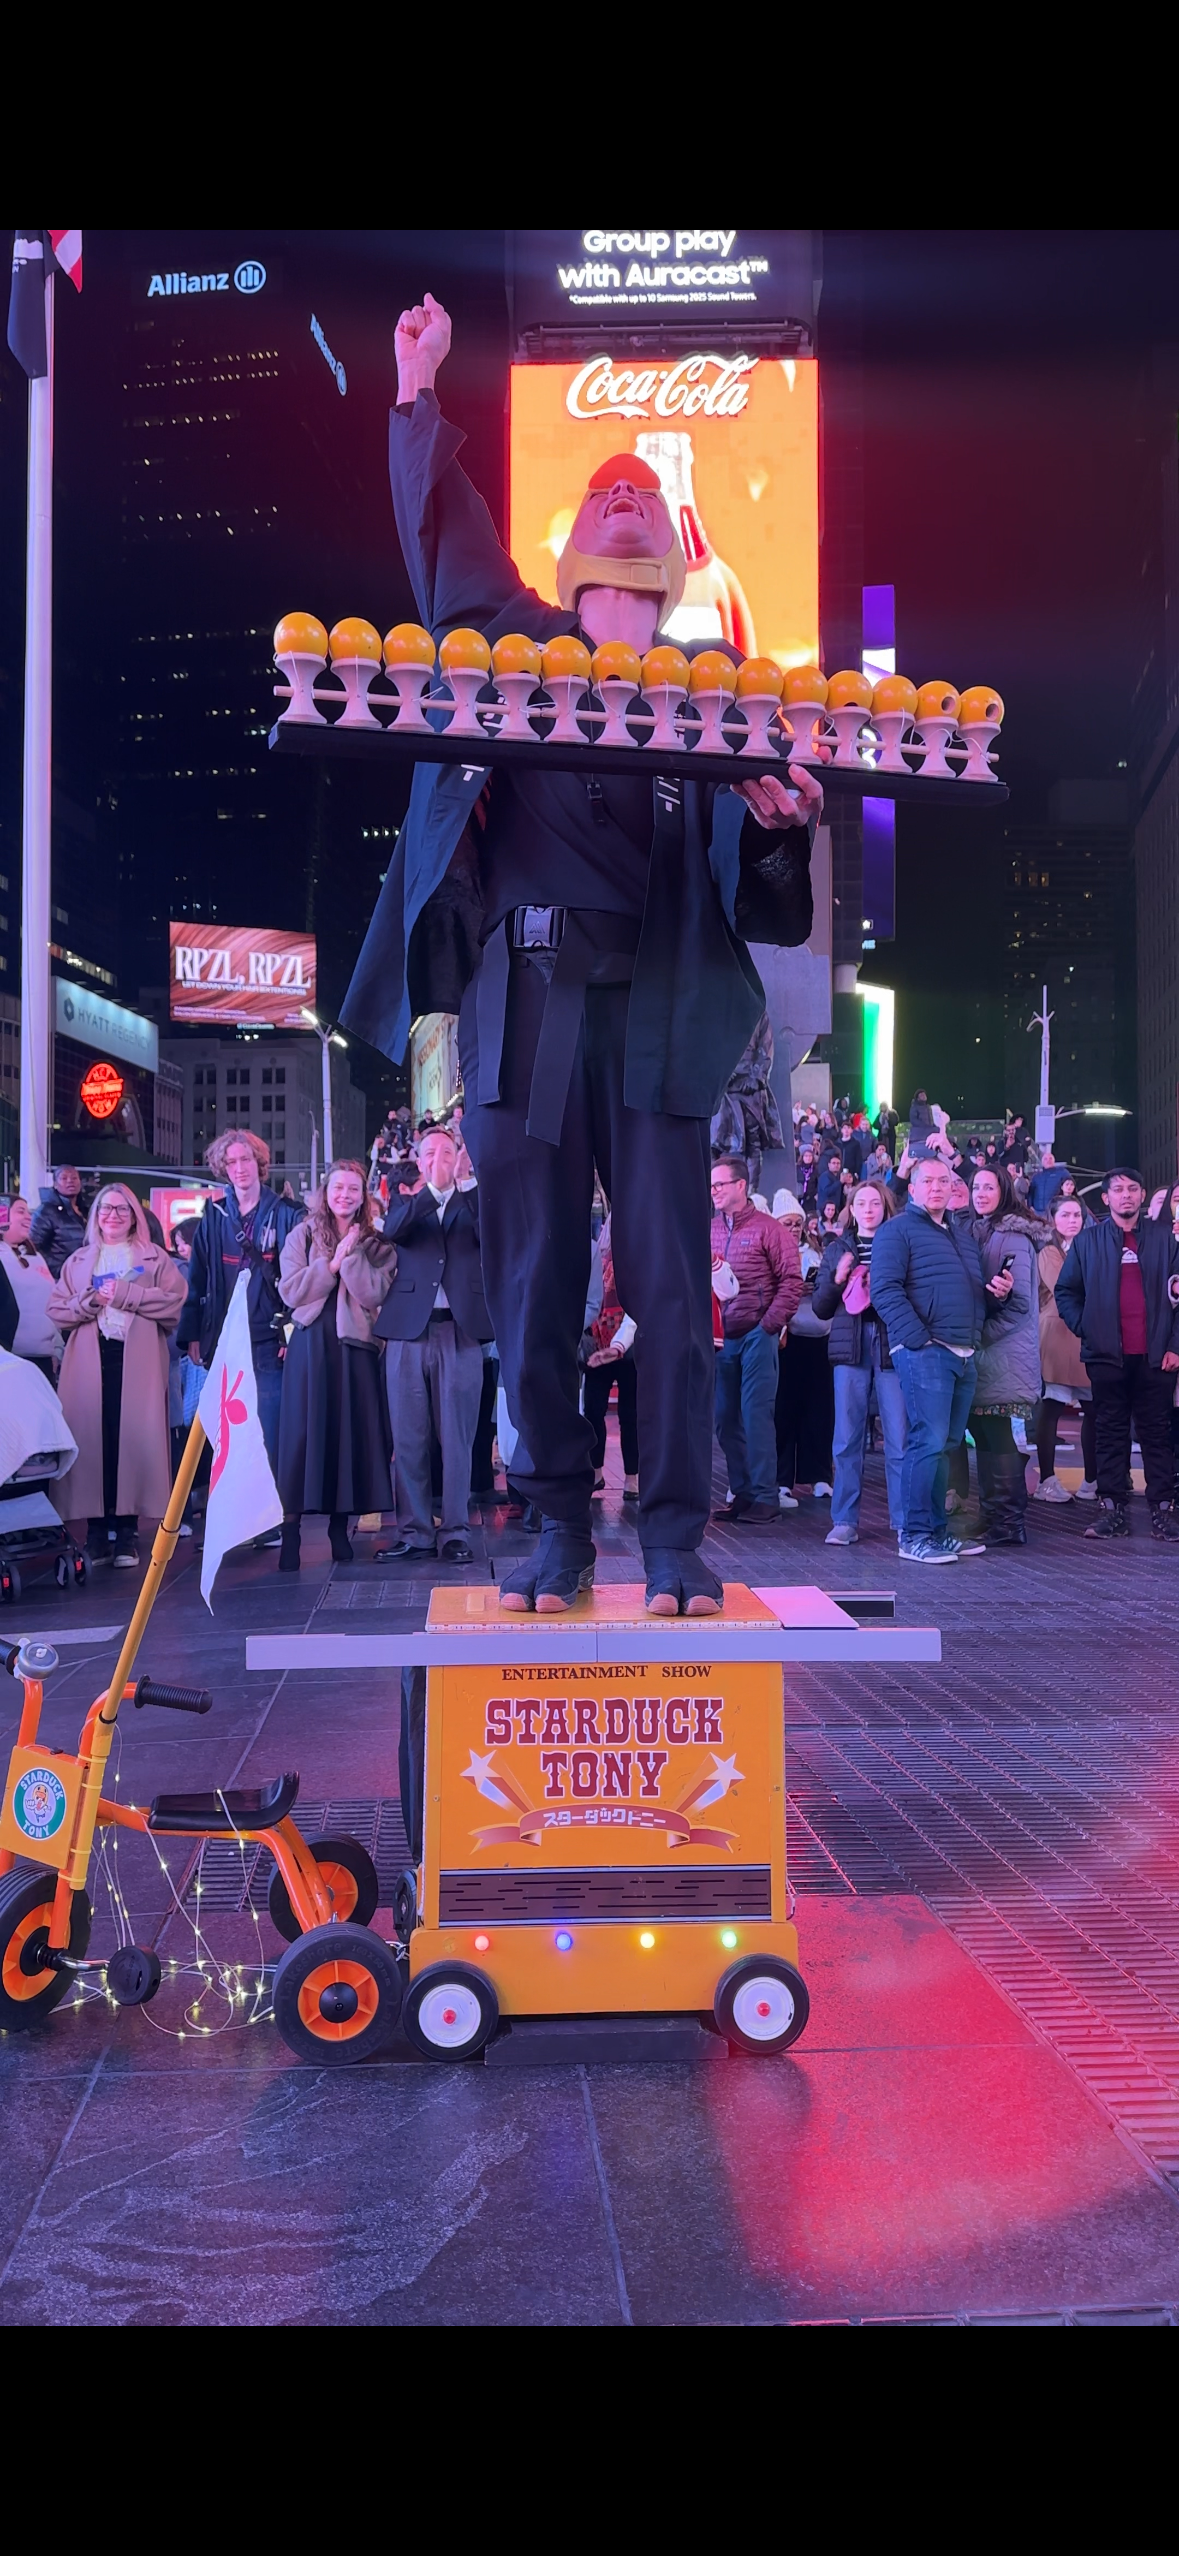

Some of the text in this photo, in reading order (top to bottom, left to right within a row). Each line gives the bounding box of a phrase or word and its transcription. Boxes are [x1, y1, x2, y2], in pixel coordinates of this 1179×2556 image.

[583, 230, 736, 258] Group play
[147, 272, 229, 297] Allianz
[558, 262, 620, 288] with
[612, 293, 628, 304] with
[628, 294, 639, 305] up
[638, 293, 647, 304] to
[647, 292, 657, 303] 10
[656, 292, 689, 304] Samsung
[689, 291, 707, 303] 2025
[707, 290, 730, 302] Sound
[565, 355, 760, 419] Coca-Cola
[174, 946, 312, 989] RPZL, RPZL
[77, 1007, 150, 1051] HYATT REGENCY
[501, 1665, 712, 1681] ENTERTAINMENT SHOW
[485, 1697, 723, 1745] STARDUCK
[20, 1770, 64, 1800] STARDUCK
[541, 1751, 668, 1798] TONY
[22, 1819, 50, 1838] TONY
[542, 1807, 666, 1827] スターダックトニー
[280, 1942, 342, 1997] Lakeshore
